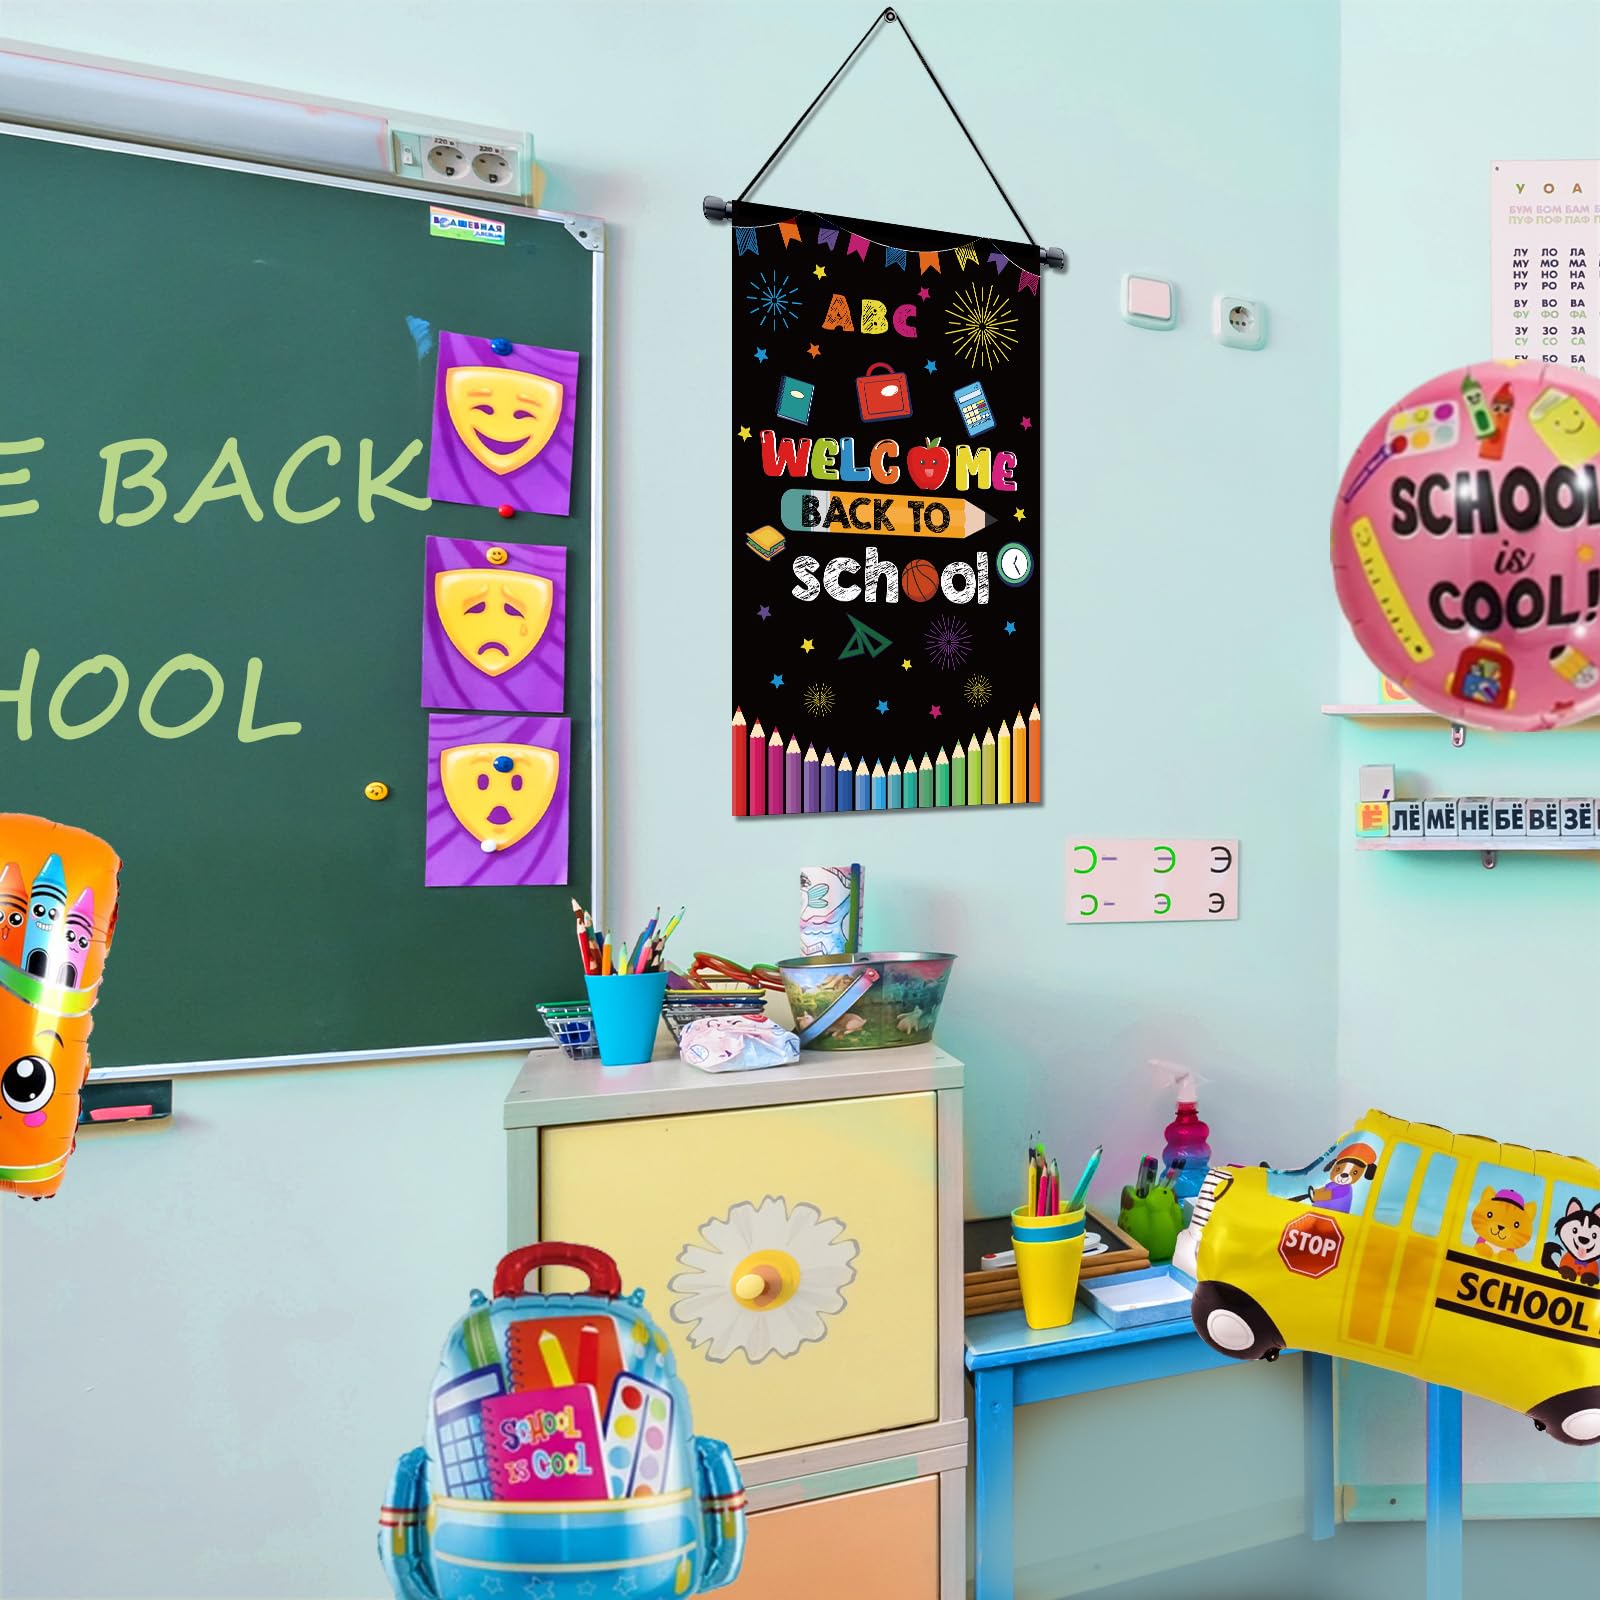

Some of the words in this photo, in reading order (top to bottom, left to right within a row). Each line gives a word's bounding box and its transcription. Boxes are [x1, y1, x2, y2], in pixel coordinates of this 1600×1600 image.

[1509, 205, 1532, 214] БУМ
[1536, 205, 1562, 214] БОМ
[1565, 205, 1590, 214] БАМ
[1513, 248, 1528, 257] ЛУ
[1541, 248, 1558, 257] ЛО
[1570, 248, 1585, 257] ЛА
[1513, 259, 1529, 268] МУ
[1540, 259, 1559, 268] МО
[1569, 259, 1587, 268] МА
[1513, 270, 1528, 279] НУ
[1541, 270, 1558, 279] НО
[1570, 270, 1585, 279] НА
[1514, 282, 1528, 290] РУ
[1542, 281, 1557, 290] РО
[1571, 282, 1585, 290] РА
[1514, 299, 1528, 308] ВУ
[1542, 299, 1558, 308] ВО
[1571, 299, 1585, 308] ВА
[822, 293, 918, 338] ABC
[1513, 310, 1530, 319] ФУ
[1541, 310, 1559, 318] ФО
[1570, 310, 1587, 319] ФА
[1514, 327, 1528, 335] ЗУ
[1542, 327, 1558, 335] ЗО
[1571, 326, 1585, 335] ЗА
[1514, 338, 1528, 346] СУ
[1542, 337, 1558, 346] СО
[1571, 337, 1585, 345] СА
[1571, 355, 1585, 363] БА
[99, 435, 432, 527] BACK
[800, 495, 895, 532] BACK
[907, 501, 951, 533] TO
[1494, 540, 1536, 575] is
[1428, 569, 1600, 633] COOL!
[1392, 804, 1421, 831] ЛЁ
[1427, 803, 1455, 830] МЁ
[1461, 804, 1489, 831] НЁ
[1495, 803, 1524, 831] БЁ
[1529, 804, 1558, 830] ВЁ
[1564, 803, 1592, 830] ЗЁ
[1210, 846, 1232, 873] Э
[1285, 1229, 1337, 1258] STOP
[1456, 1272, 1589, 1332] SCHOOL
